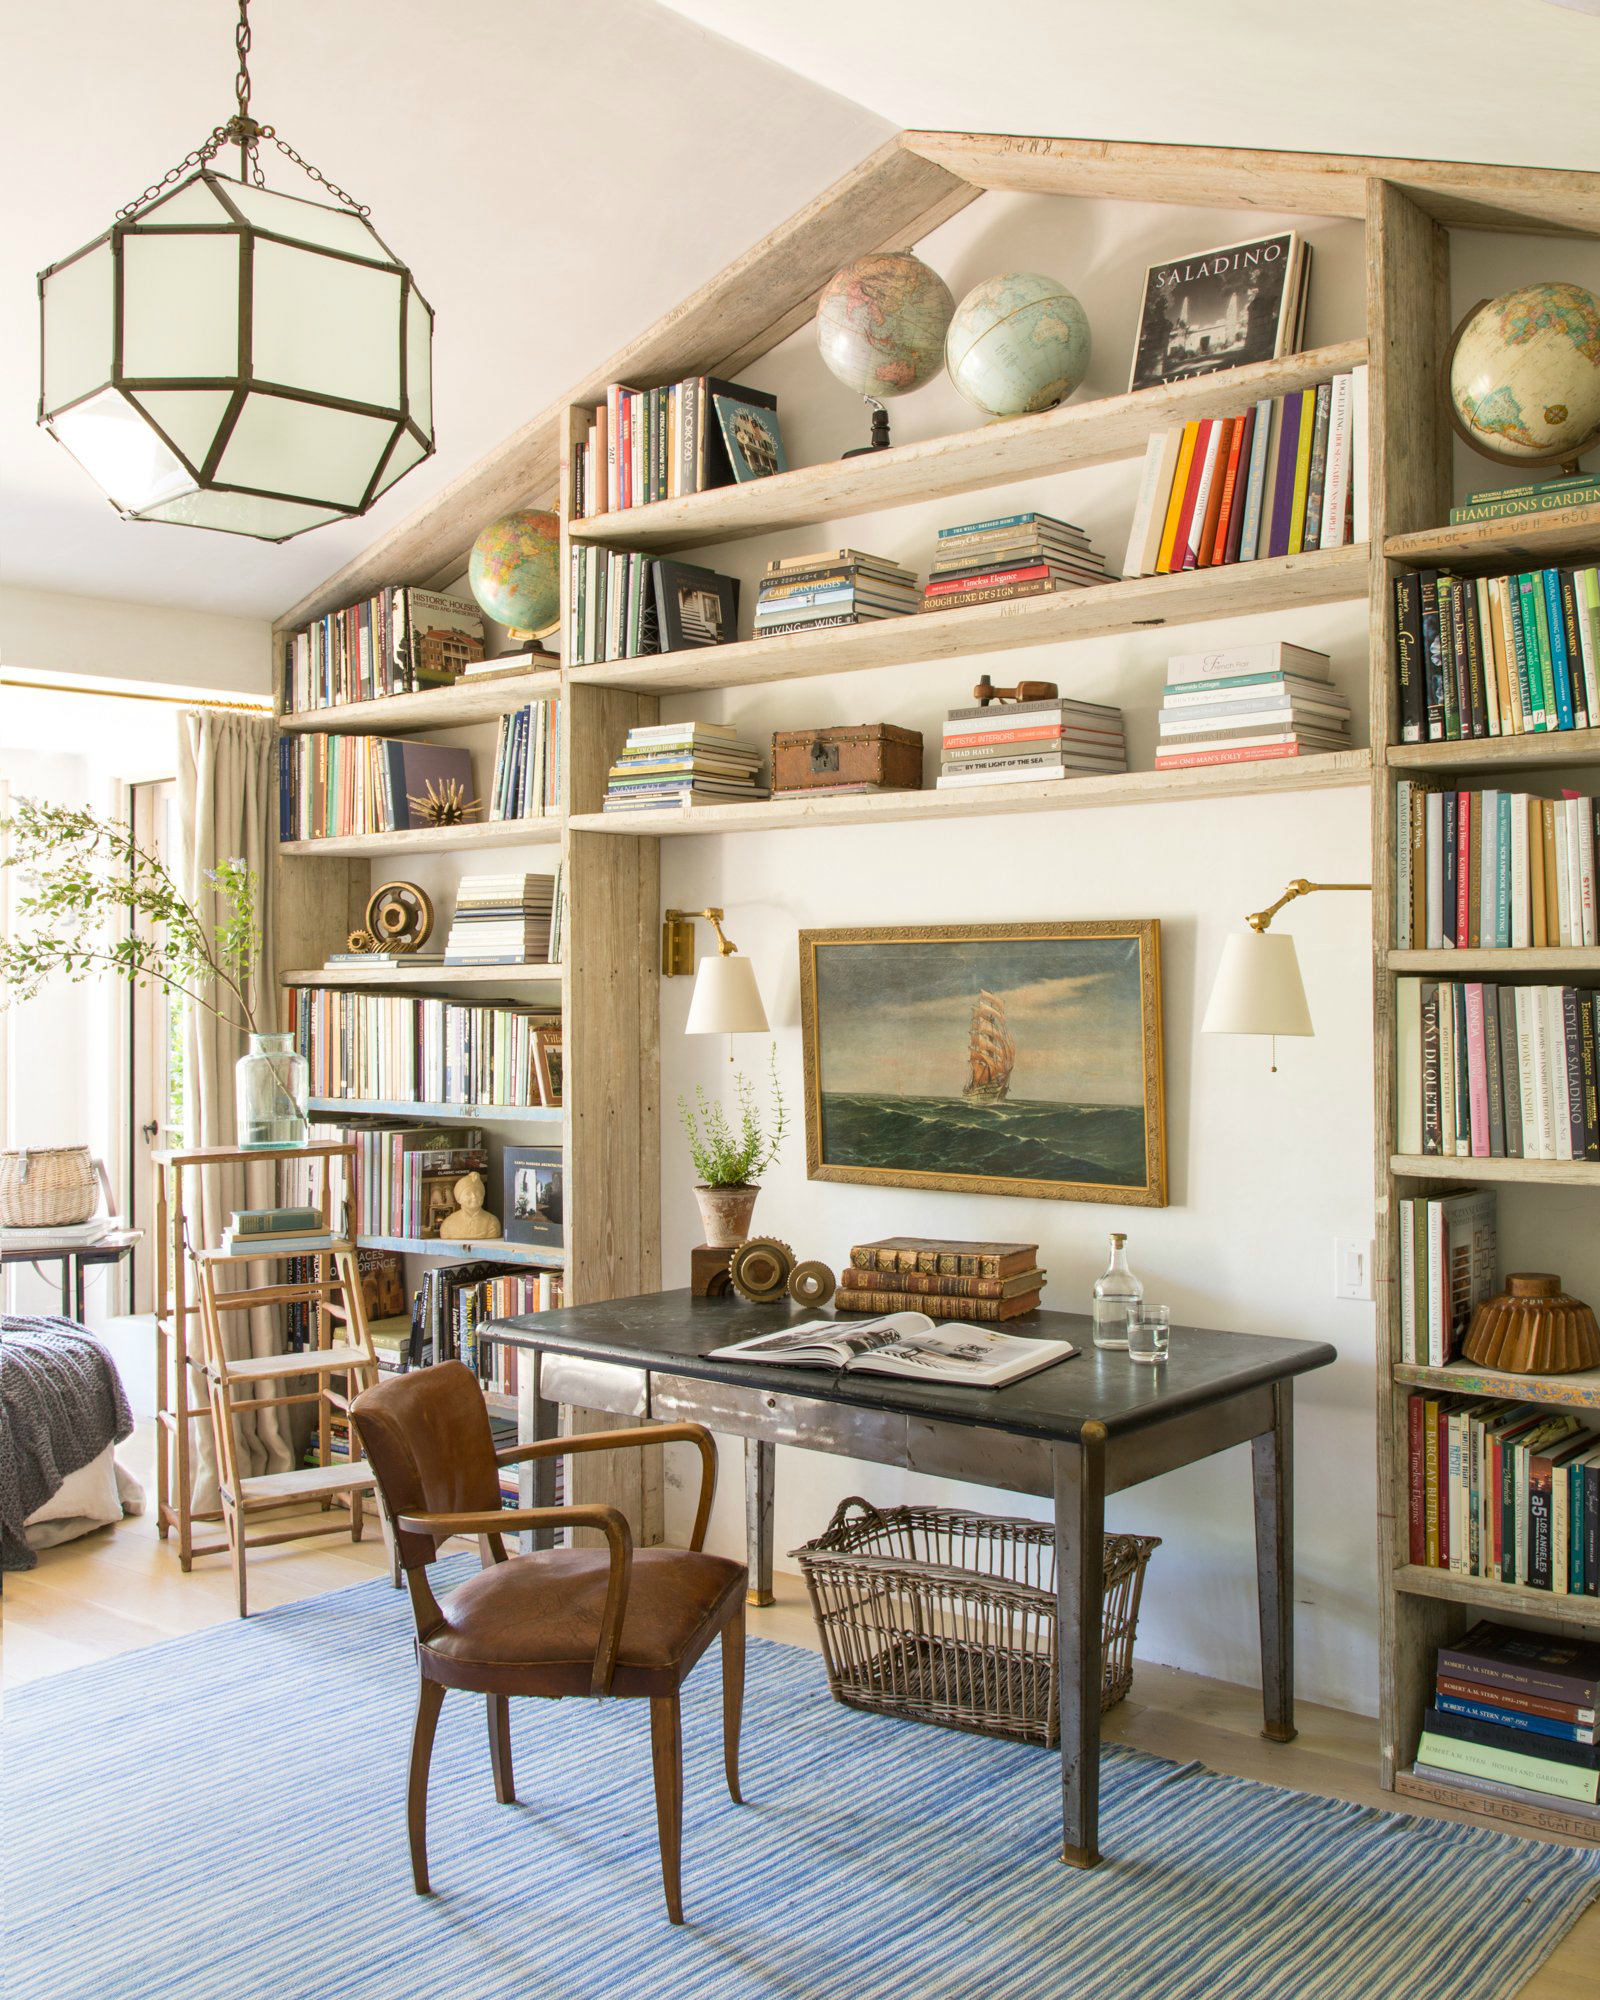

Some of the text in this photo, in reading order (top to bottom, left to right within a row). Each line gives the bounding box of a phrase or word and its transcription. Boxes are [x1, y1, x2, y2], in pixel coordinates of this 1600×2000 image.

[1156, 245, 1281, 288] SALADINO
[685, 383, 694, 410] NEW
[684, 411, 693, 440] YORK
[1456, 499, 1537, 522] HAMPTONS
[769, 585, 809, 597] CARIBBEAN
[810, 580, 841, 592] HOUSES
[962, 573, 1017, 588] Timeless Elegance
[413, 593, 480, 613] HISTORIC HOUSES
[924, 586, 1014, 609] ROUGH LUXE DESIGN
[766, 616, 843, 636] LIVING WINE
[1453, 586, 1465, 655] Stone by Design
[1548, 574, 1561, 652] NATURAL SWIMMING POOLS
[1564, 585, 1576, 656] GARDEN ORNAMENT
[1439, 601, 1448, 655] HIGHGROVE
[1468, 618, 1476, 657] LANDSCAPE
[1397, 632, 1414, 685] Gardening
[1512, 600, 1531, 715] THE GARDENER'S PALETTE
[1530, 668, 1538, 695] FLOWERS
[946, 731, 1015, 746] ARTISTIC INTERIORS
[951, 748, 995, 759] THAD HAYES
[965, 763, 974, 771] BY
[1179, 757, 1197, 766] ONE
[1198, 754, 1219, 764] MAN'S
[1220, 752, 1243, 762] FOLLY
[614, 782, 667, 793] NANTUCKET
[1469, 990, 1480, 1038] VERANDA
[1581, 1002, 1592, 1075] Essential Elegance
[1423, 1003, 1437, 1131] TONY DUQUETTE
[1541, 1051, 1546, 1059] TO
[1565, 1004, 1582, 1123] STYLE BY SALADINO
[1505, 1027, 1519, 1123] AXEL VERVOORDT
[1521, 1034, 1534, 1124] ROOMS TO INSPIRE
[1556, 1075, 1564, 1100] Inspire
[1558, 1102, 1566, 1110] by
[1560, 1128, 1568, 1140] Sea
[358, 1257, 397, 1272] ORENCE
[486, 1283, 494, 1312] Rome
[1450, 1445, 1460, 1476] FREESTYLE
[1412, 1450, 1421, 1525] Timeless Elegance
[1427, 1430, 1437, 1533] BARCLAY BUTERA
[1532, 1495, 1547, 1517] a5
[1444, 1660, 1499, 1677] ROBERT STERN
[1444, 1683, 1499, 1700] ROBERT STERN
[1443, 1703, 1499, 1720] ROBERT STERN
[1425, 1745, 1569, 1786] ROBERT STERN HOUSES AND GARDENS
